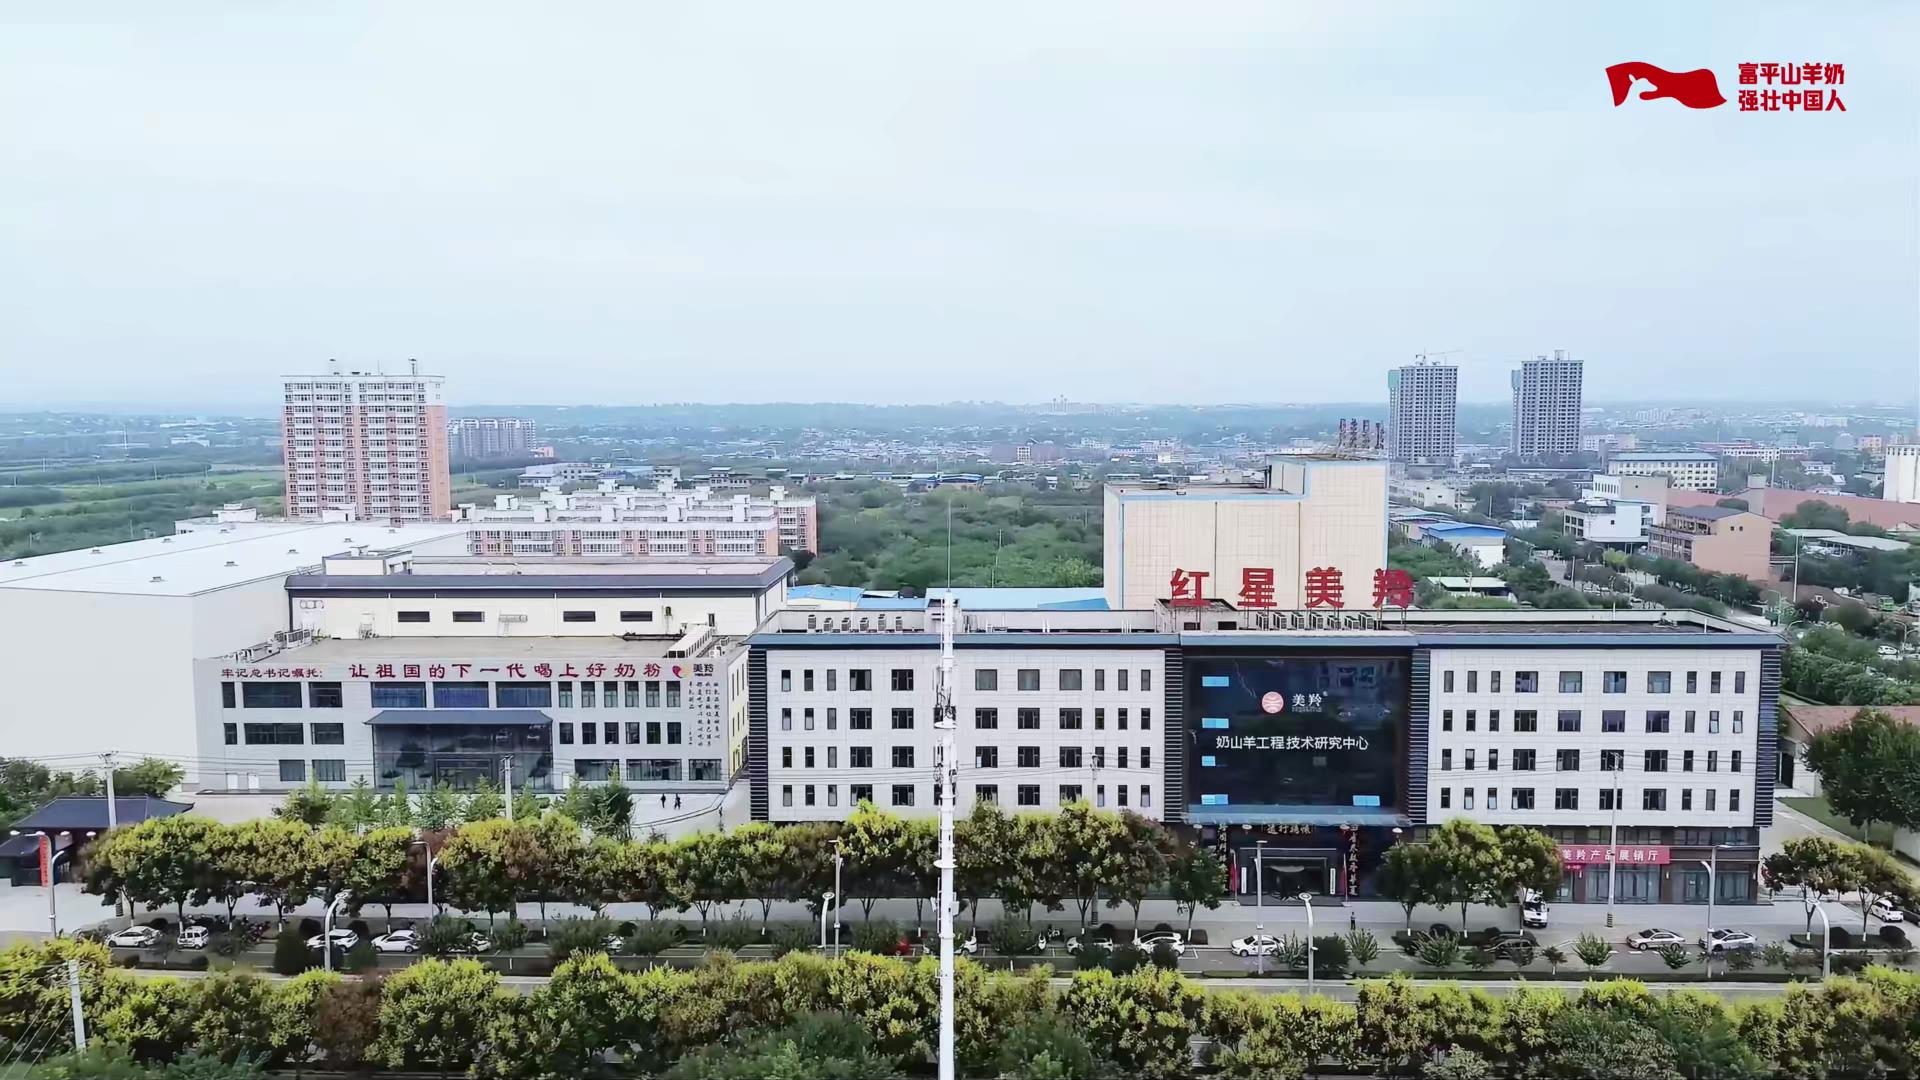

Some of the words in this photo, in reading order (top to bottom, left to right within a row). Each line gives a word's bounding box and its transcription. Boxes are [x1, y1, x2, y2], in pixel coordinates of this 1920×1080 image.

[1170, 567, 1414, 609] 红星美羚
[349, 663, 661, 679] 让祖国的下一代喝上好奶粉
[693, 663, 714, 673] 美羚
[1292, 693, 1322, 707] 美羚
[1216, 736, 1369, 750] 奶山羊工程技术研究中心
